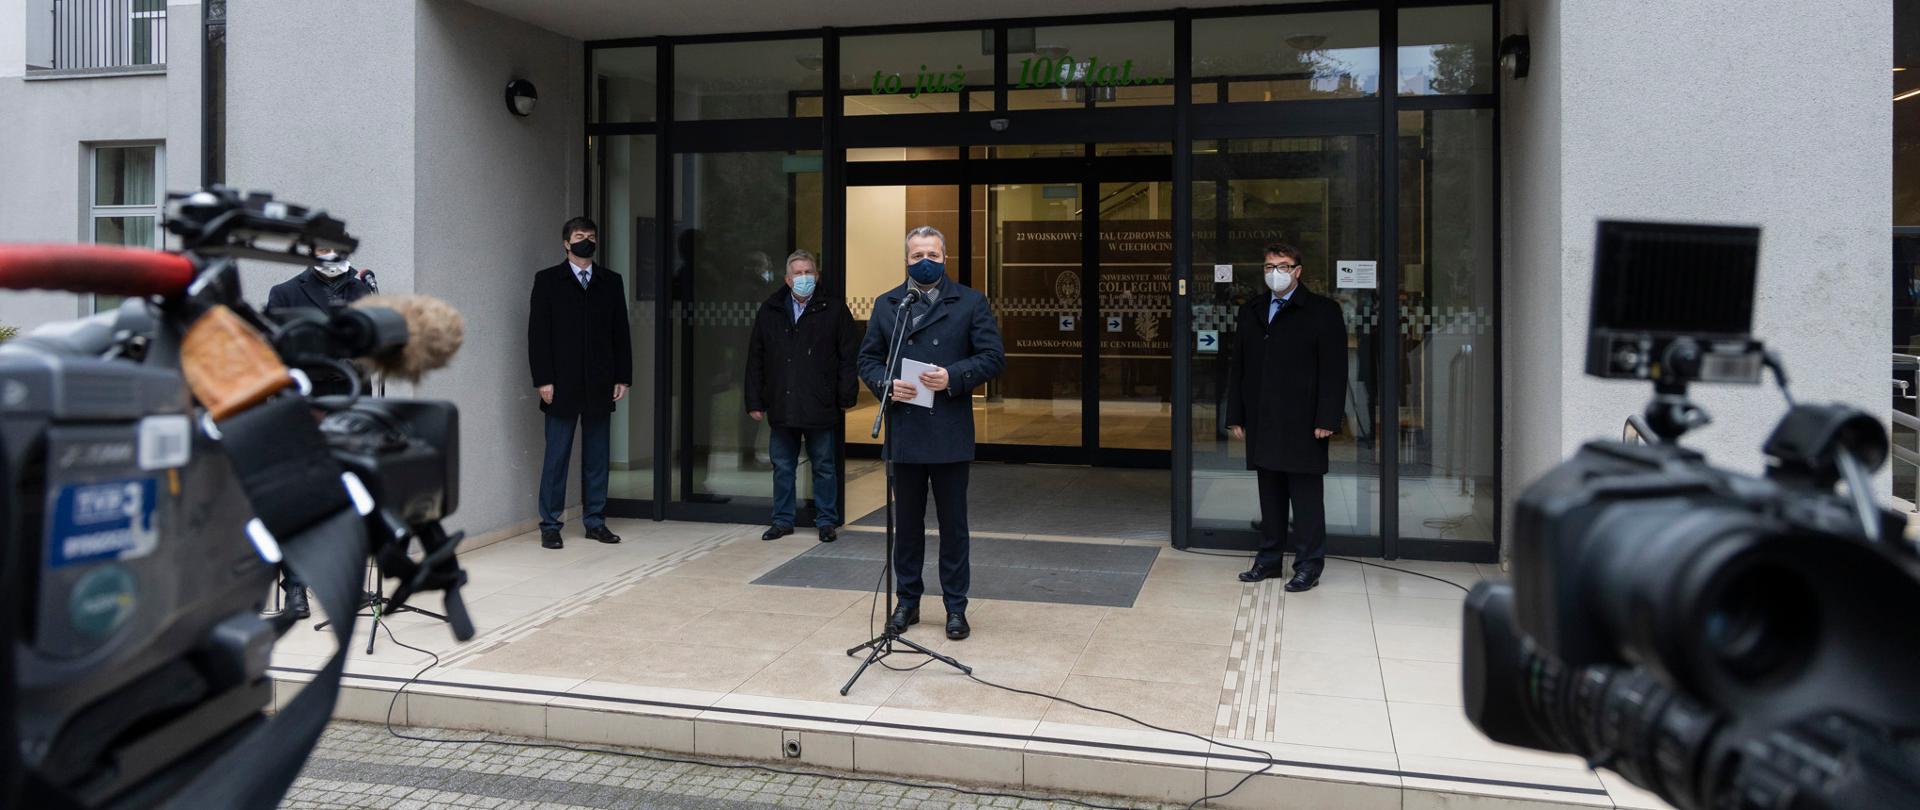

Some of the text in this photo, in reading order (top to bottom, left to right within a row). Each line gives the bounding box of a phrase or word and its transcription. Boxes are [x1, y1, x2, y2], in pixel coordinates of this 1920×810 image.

[871, 55, 1167, 99] to już 100 lat...
[1016, 232, 1025, 241] 22
[1026, 231, 1078, 241] WOJSKOWY
[1098, 281, 1172, 293] COLLEGIUM
